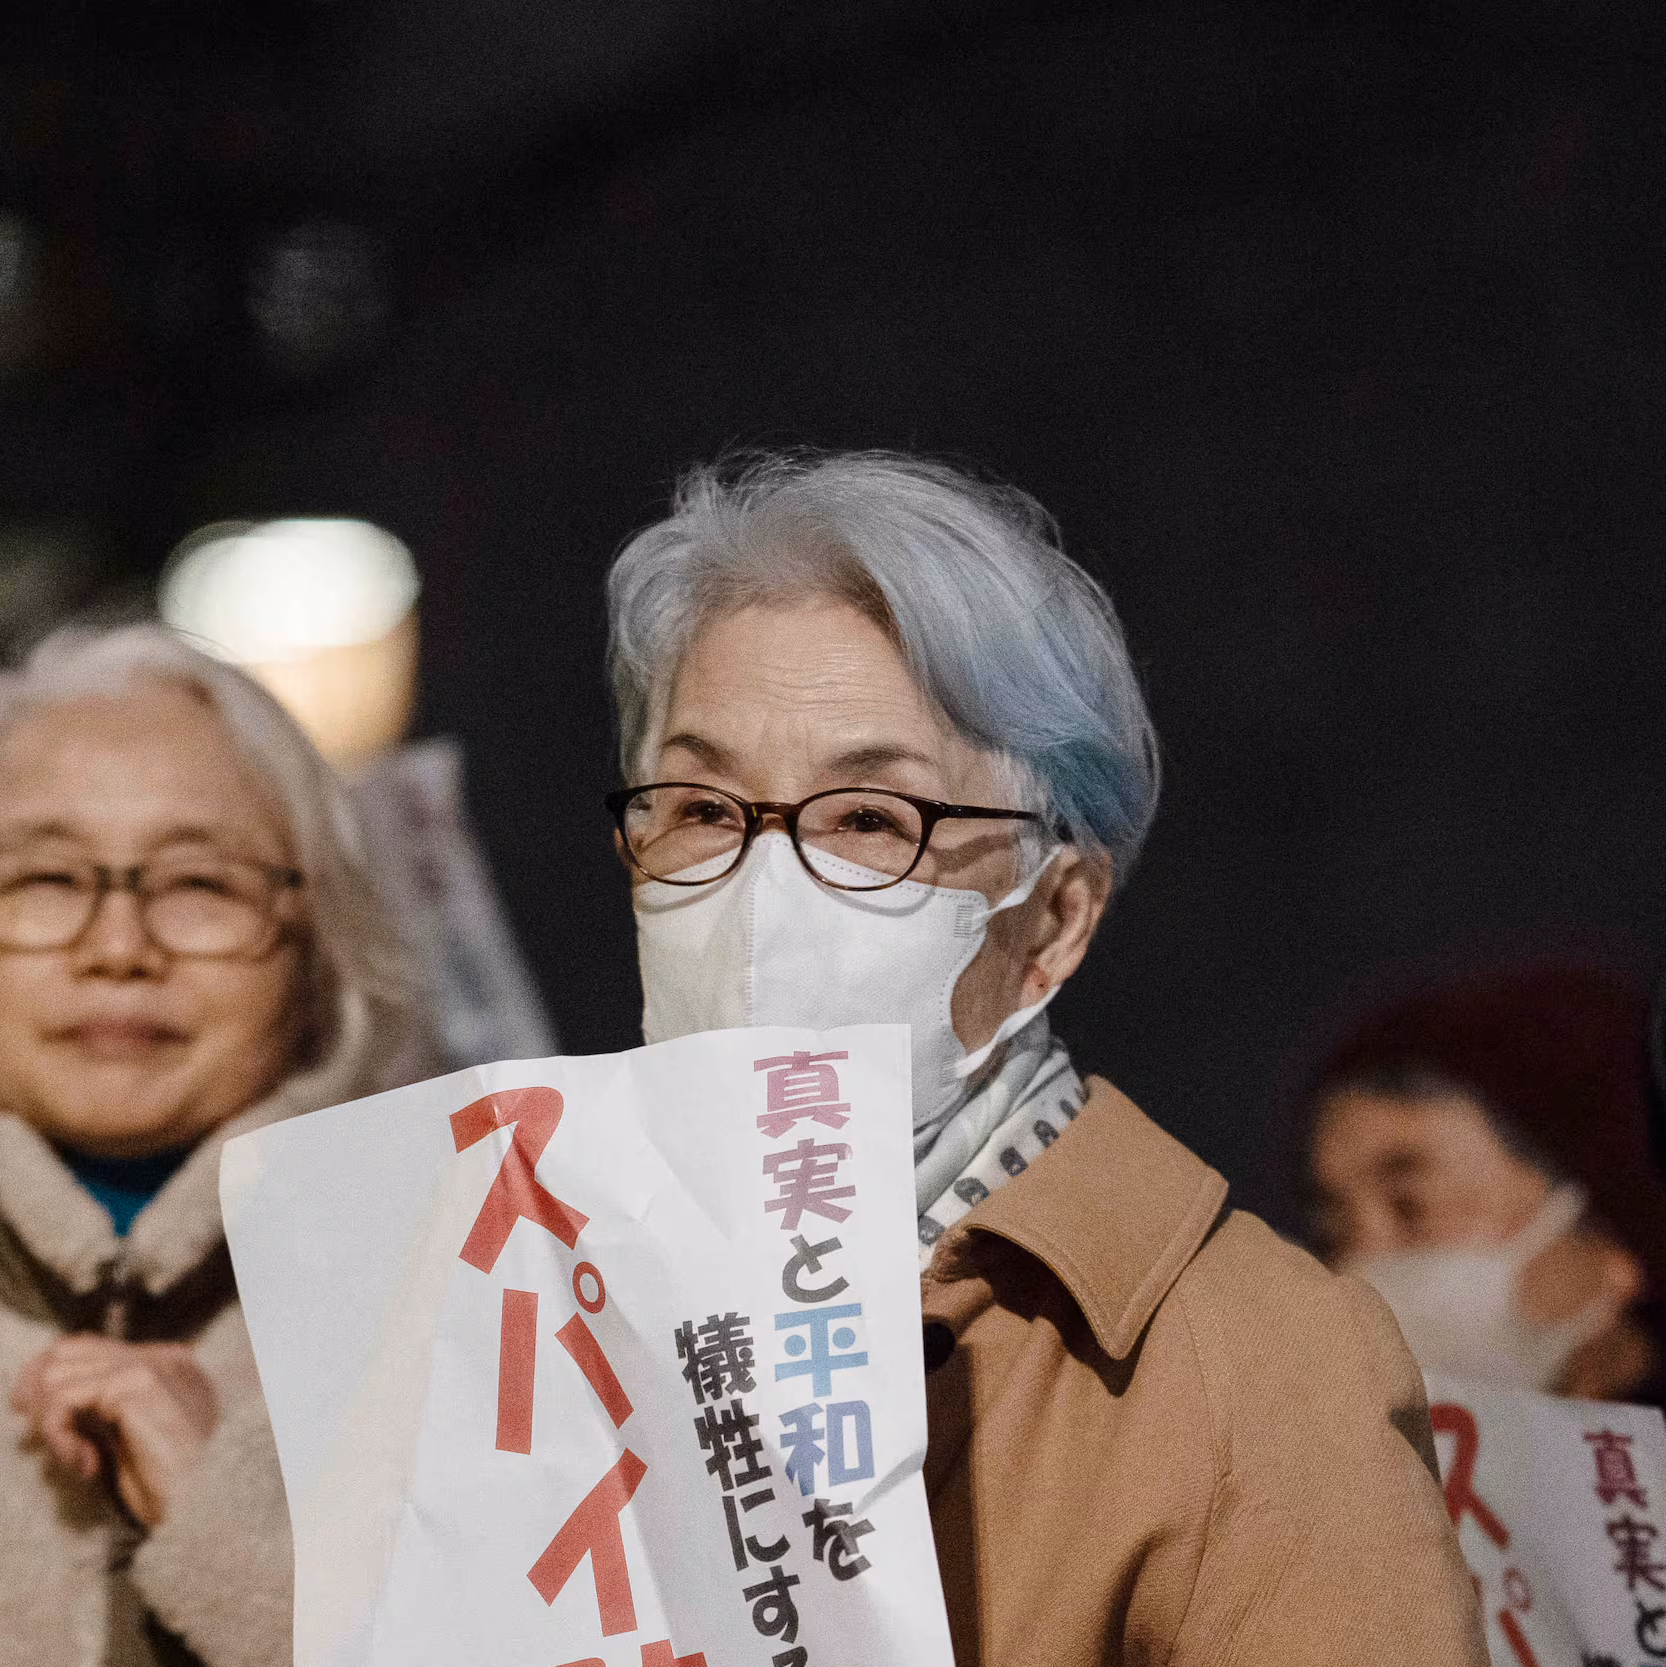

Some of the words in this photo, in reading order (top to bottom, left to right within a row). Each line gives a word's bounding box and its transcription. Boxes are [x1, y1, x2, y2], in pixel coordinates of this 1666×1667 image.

[751, 1048, 878, 1586] 真実と平和を
